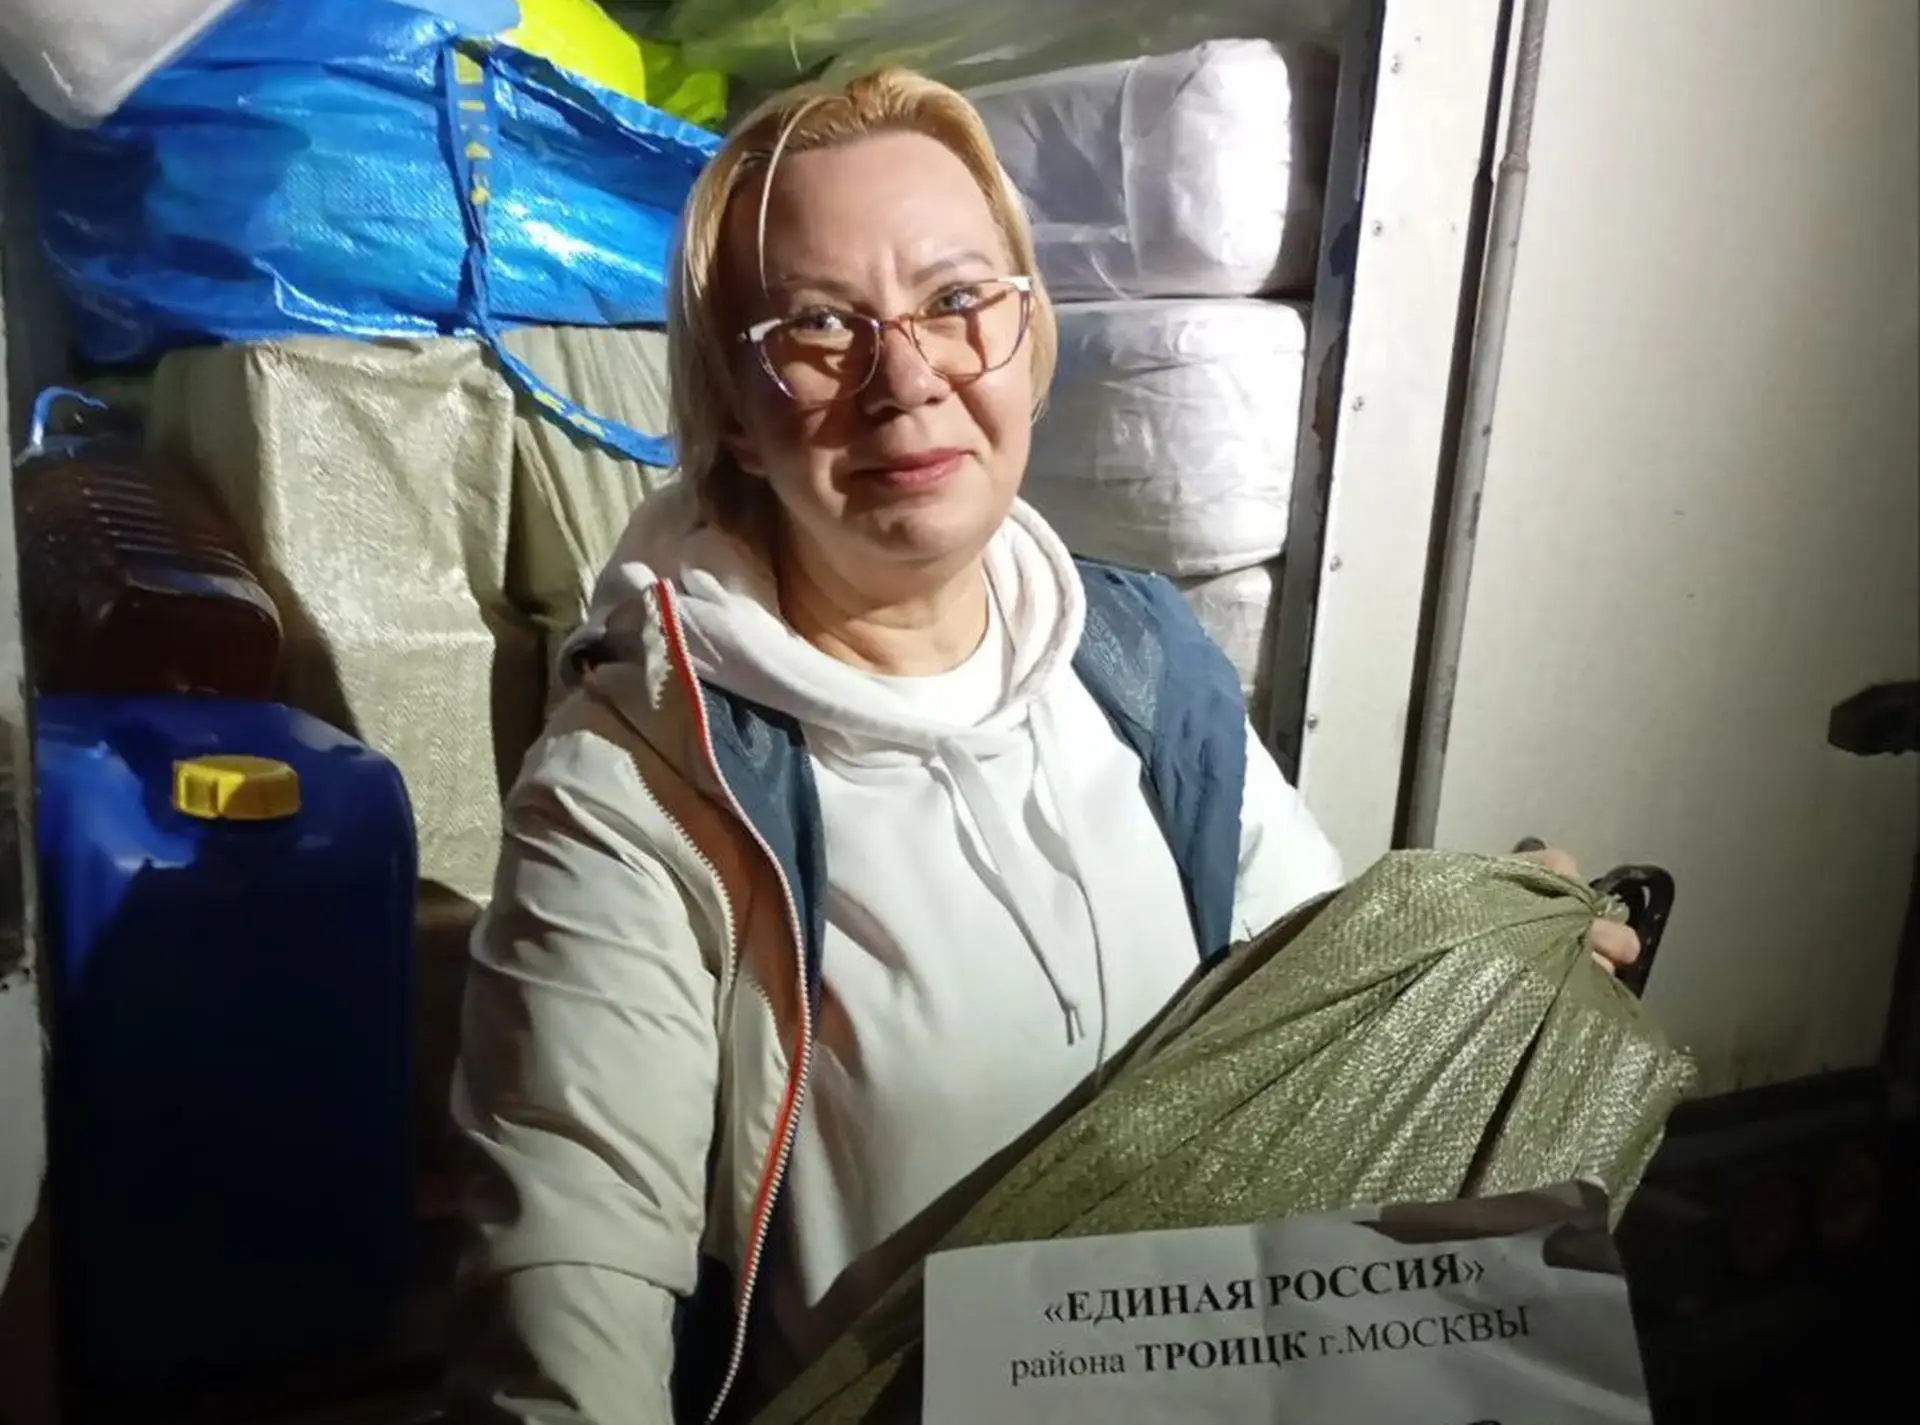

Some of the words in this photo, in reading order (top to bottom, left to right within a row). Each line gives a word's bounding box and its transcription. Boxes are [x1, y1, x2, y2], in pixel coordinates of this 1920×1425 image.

[1043, 1278, 1255, 1327] «ЕДИНАЯ
[1267, 1252, 1486, 1307] РОССИЯ»
[1010, 1350, 1126, 1387] района
[1135, 1329, 1308, 1368] ТРОИЦК
